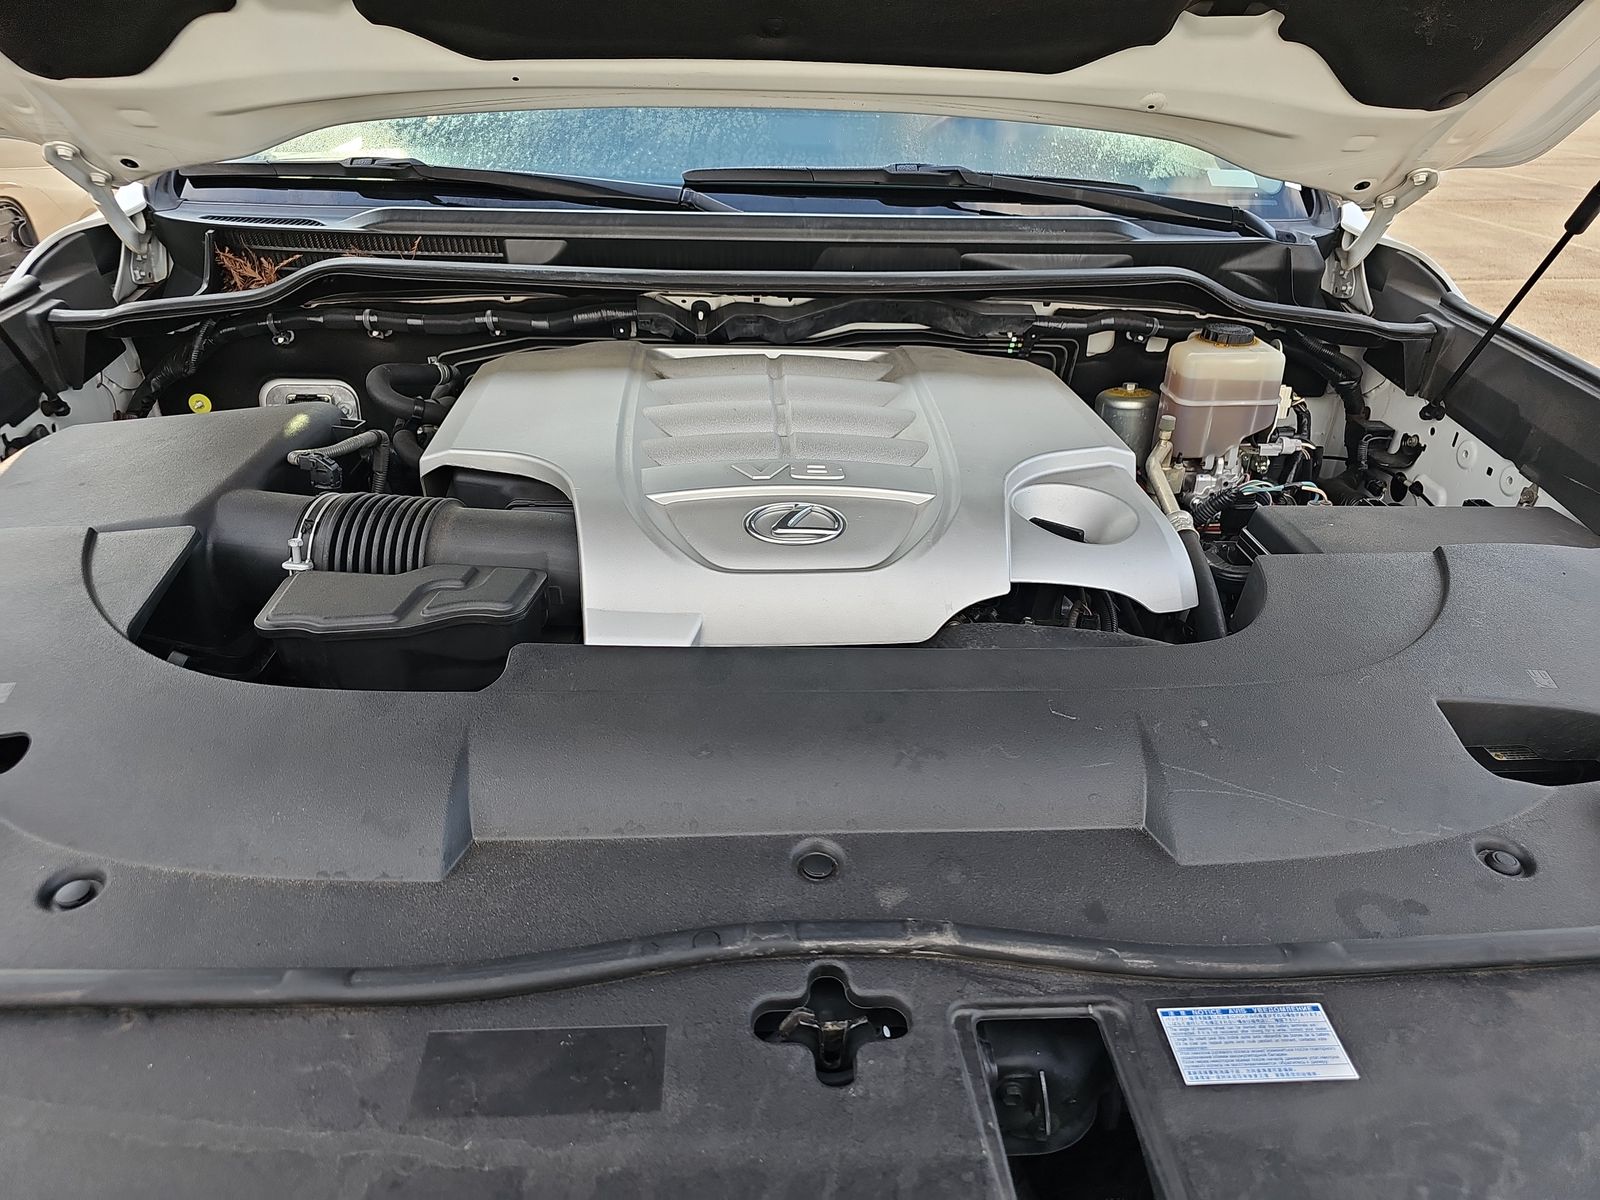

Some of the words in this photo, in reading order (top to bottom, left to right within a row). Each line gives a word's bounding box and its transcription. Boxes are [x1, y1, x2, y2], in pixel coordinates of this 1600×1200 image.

[730, 463, 845, 481] V8
[1192, 1008, 1221, 1016] NOTICE
[1228, 1007, 1247, 1015] AVIS
